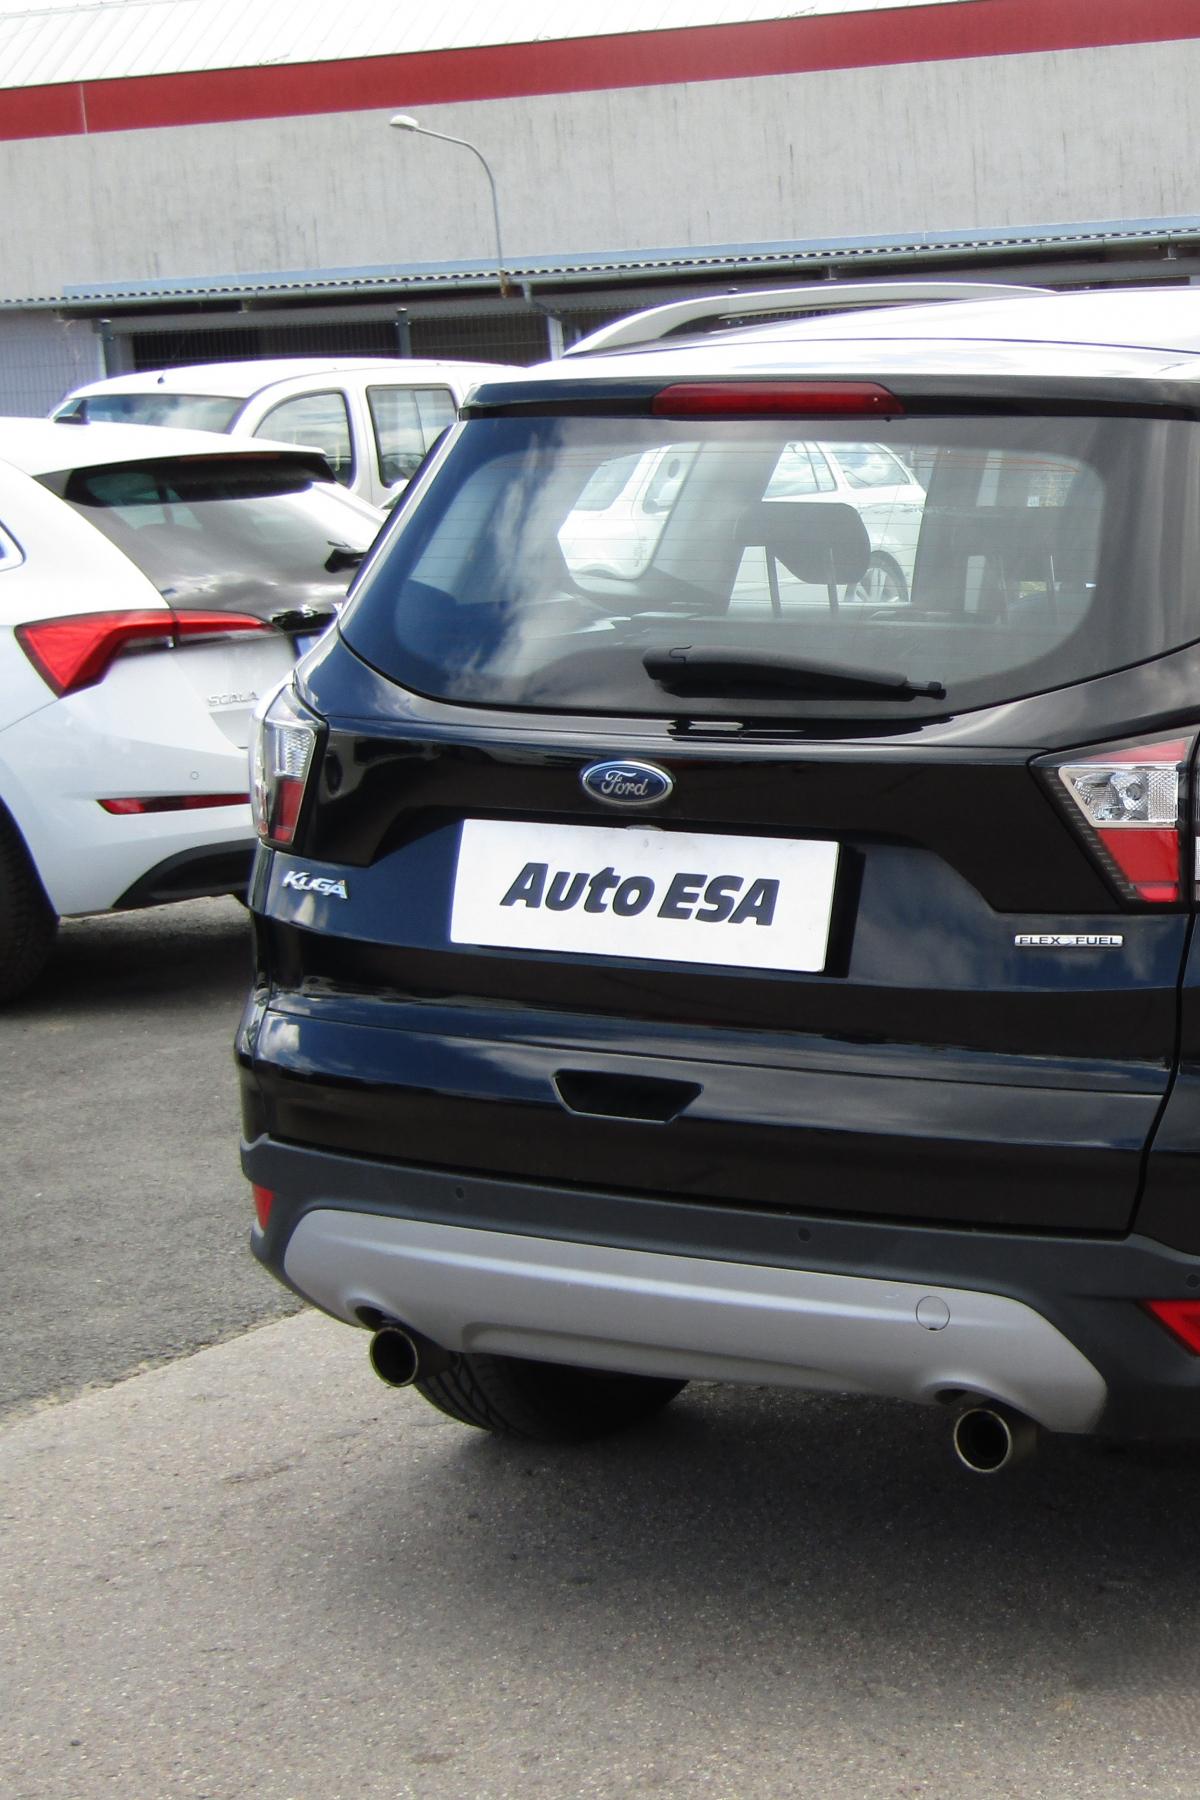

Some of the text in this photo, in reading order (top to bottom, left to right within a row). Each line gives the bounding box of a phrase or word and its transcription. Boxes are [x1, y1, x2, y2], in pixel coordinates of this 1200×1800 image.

[207, 691, 259, 706] SCALA
[601, 770, 649, 797] Ford
[282, 870, 348, 899] KUGA
[500, 862, 780, 926] Auto ESA
[1019, 936, 1119, 945] FLEX FUEL
